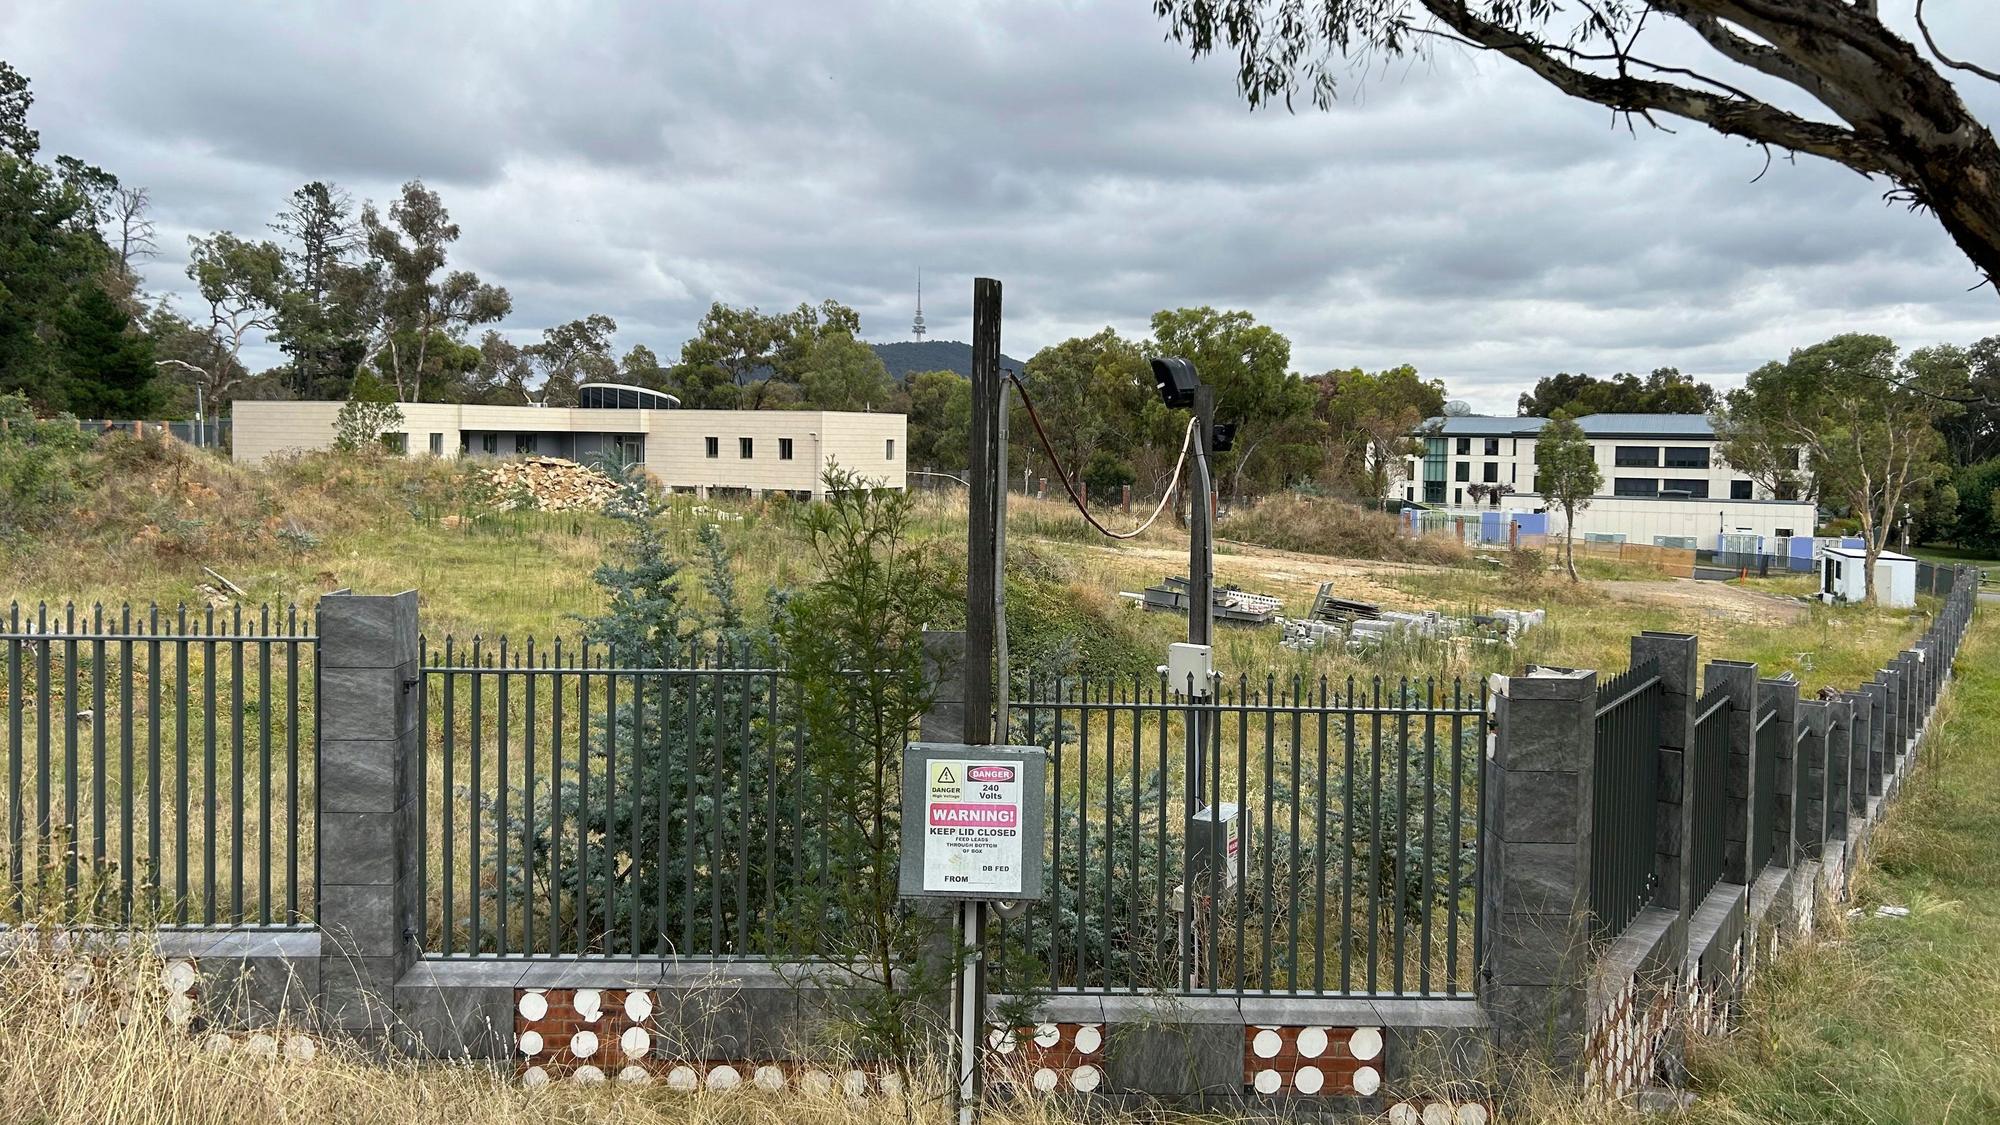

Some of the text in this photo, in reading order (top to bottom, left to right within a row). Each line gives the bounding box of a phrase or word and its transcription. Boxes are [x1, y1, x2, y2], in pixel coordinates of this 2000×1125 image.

[982, 784, 999, 792] 240
[979, 792, 1002, 800] Volts
[932, 809, 1014, 822] WARNING!
[929, 827, 1017, 837] KEEP LID CLOSED
[944, 875, 969, 883] FROM
